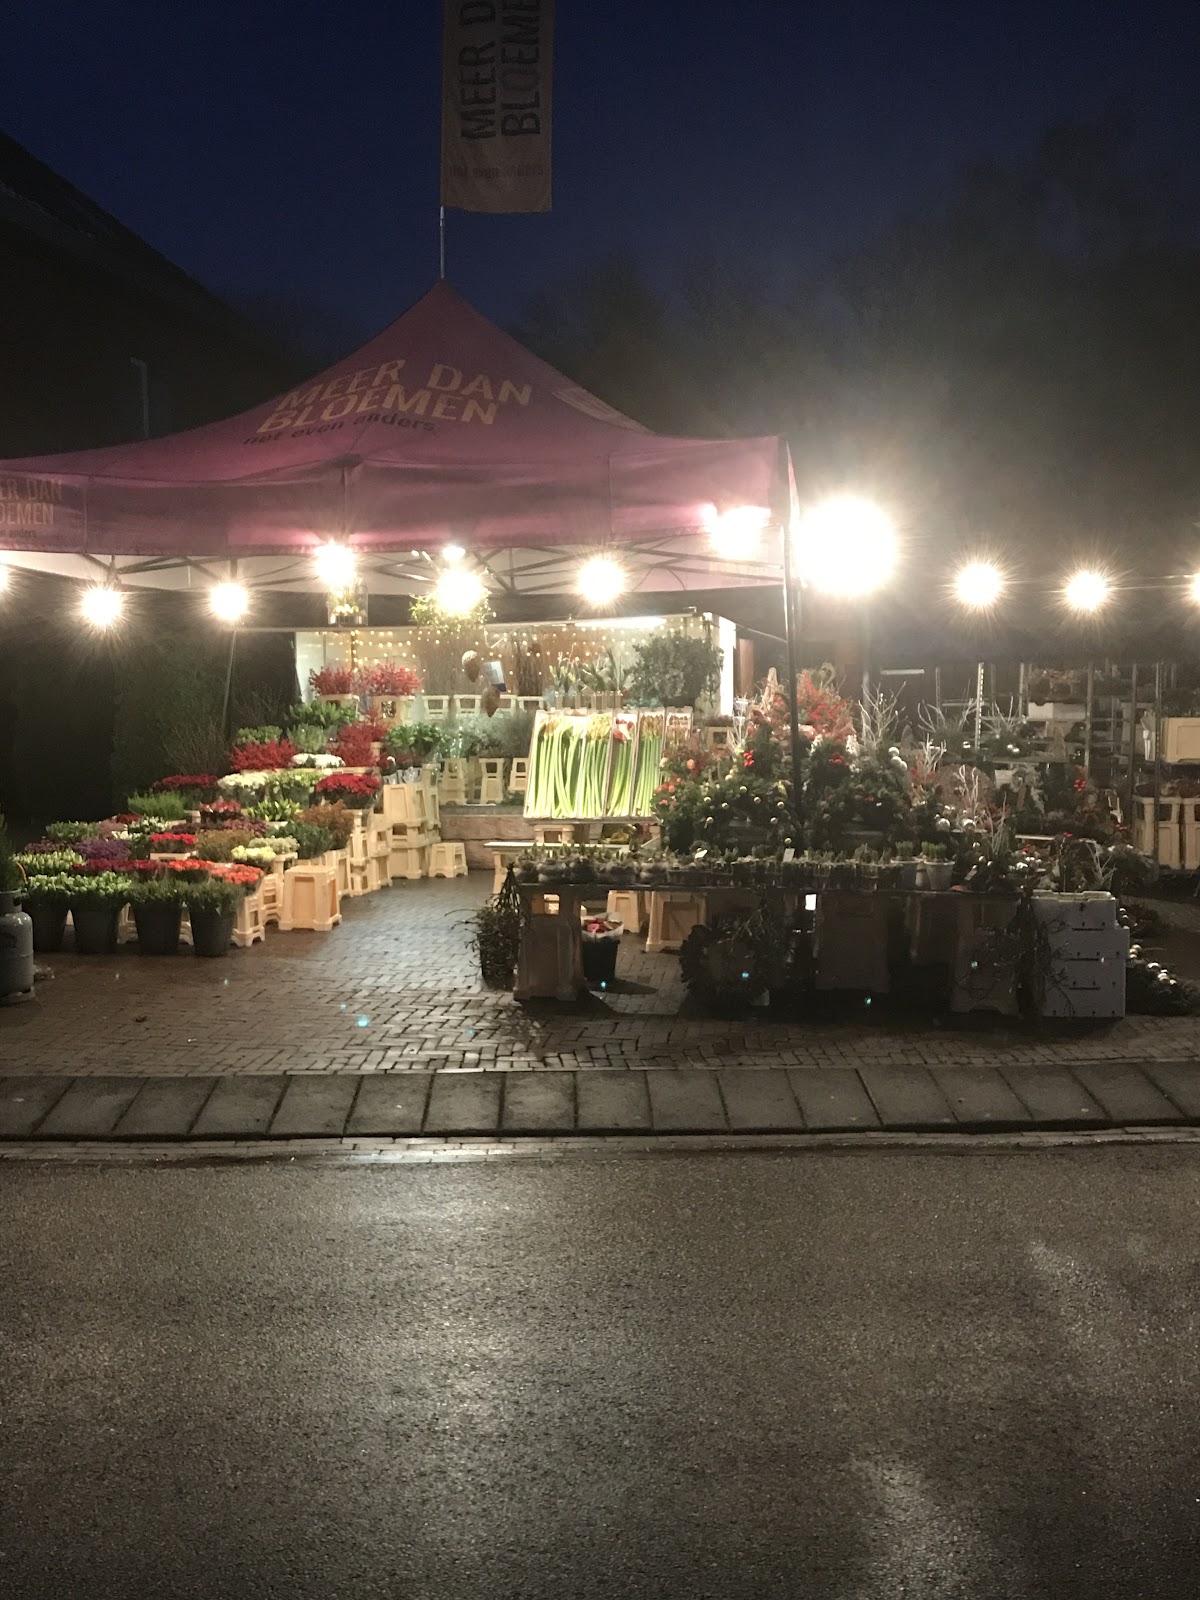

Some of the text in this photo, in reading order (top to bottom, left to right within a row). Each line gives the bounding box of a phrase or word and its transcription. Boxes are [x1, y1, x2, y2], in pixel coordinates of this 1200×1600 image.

[458, 41, 496, 139] MEER
[256, 383, 498, 434] BLOEMEN
[274, 358, 408, 412] MEER
[427, 362, 531, 406] DAN
[353, 412, 436, 431] anders
